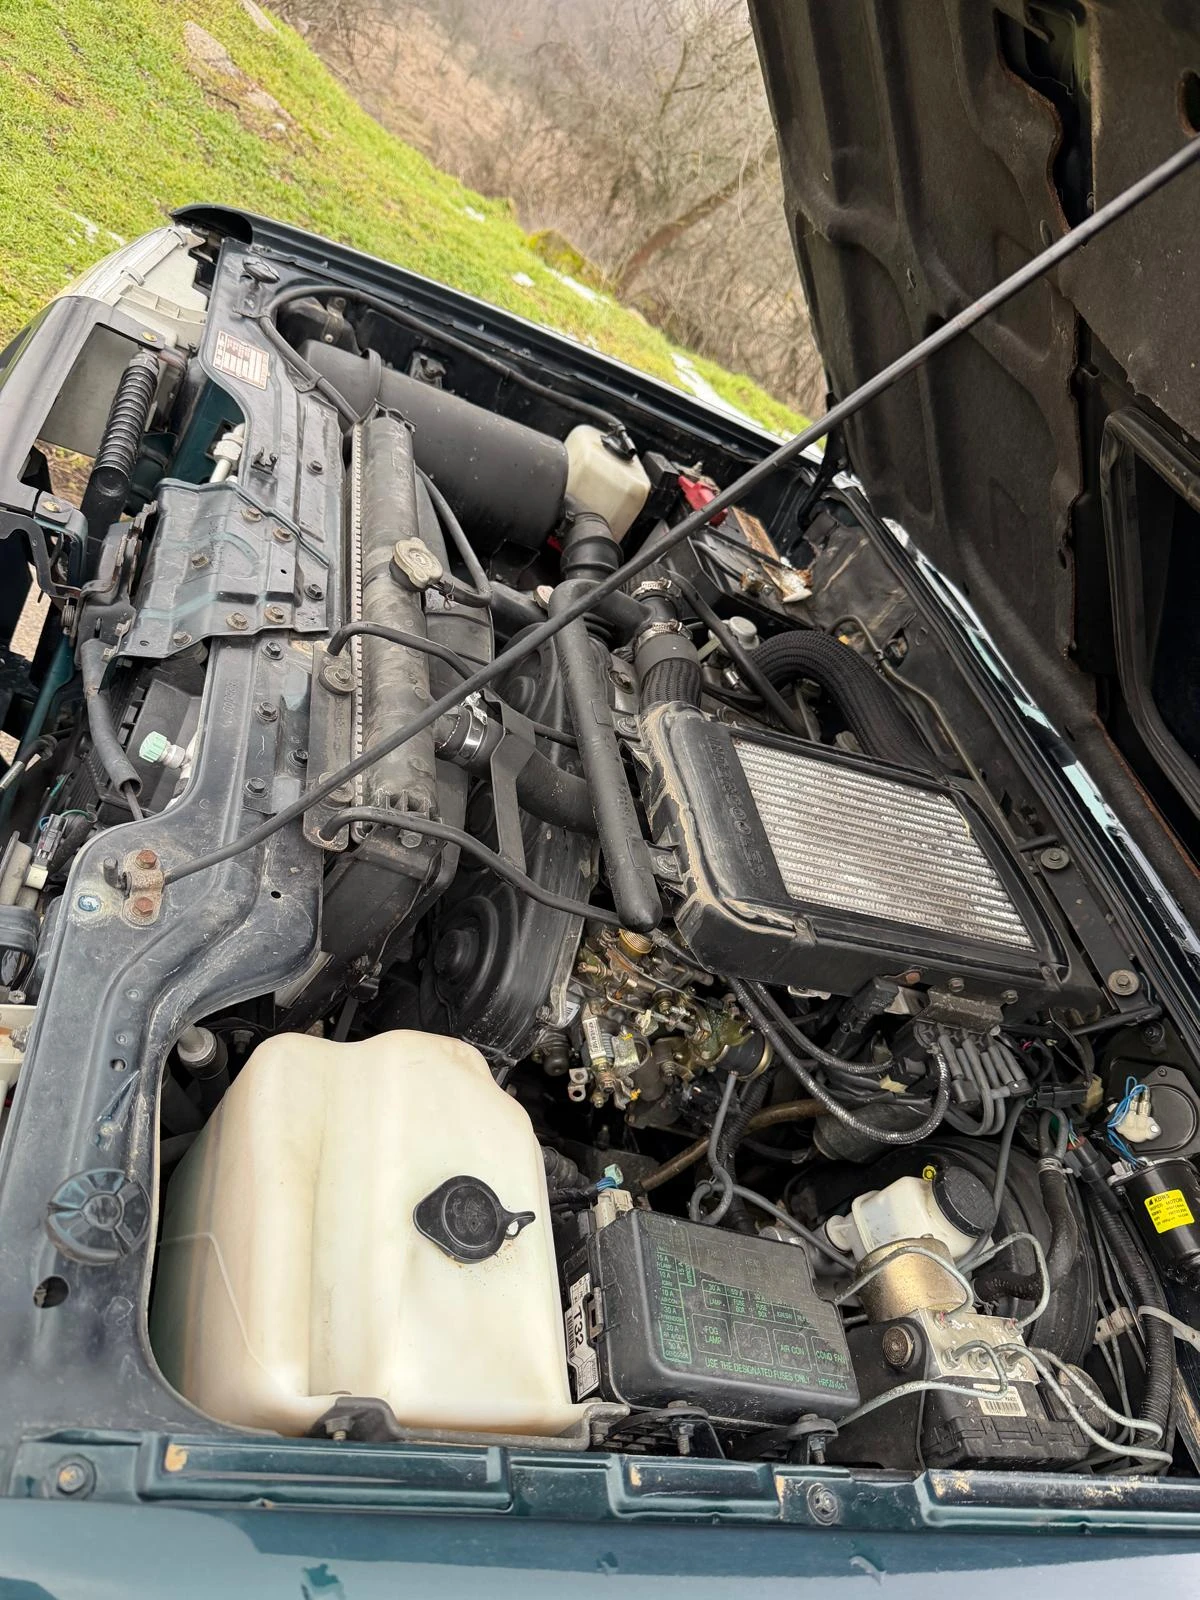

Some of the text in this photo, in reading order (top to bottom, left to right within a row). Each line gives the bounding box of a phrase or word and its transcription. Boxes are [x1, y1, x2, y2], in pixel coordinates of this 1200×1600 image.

[573, 1305, 584, 1348] T32
[704, 1326, 719, 1335] FOG
[705, 1335, 722, 1344] LAMP
[791, 1346, 805, 1355] CON
[816, 1351, 832, 1361] COND
[705, 1358, 810, 1384] USE THE DESIGNATED FUSES ONLY
